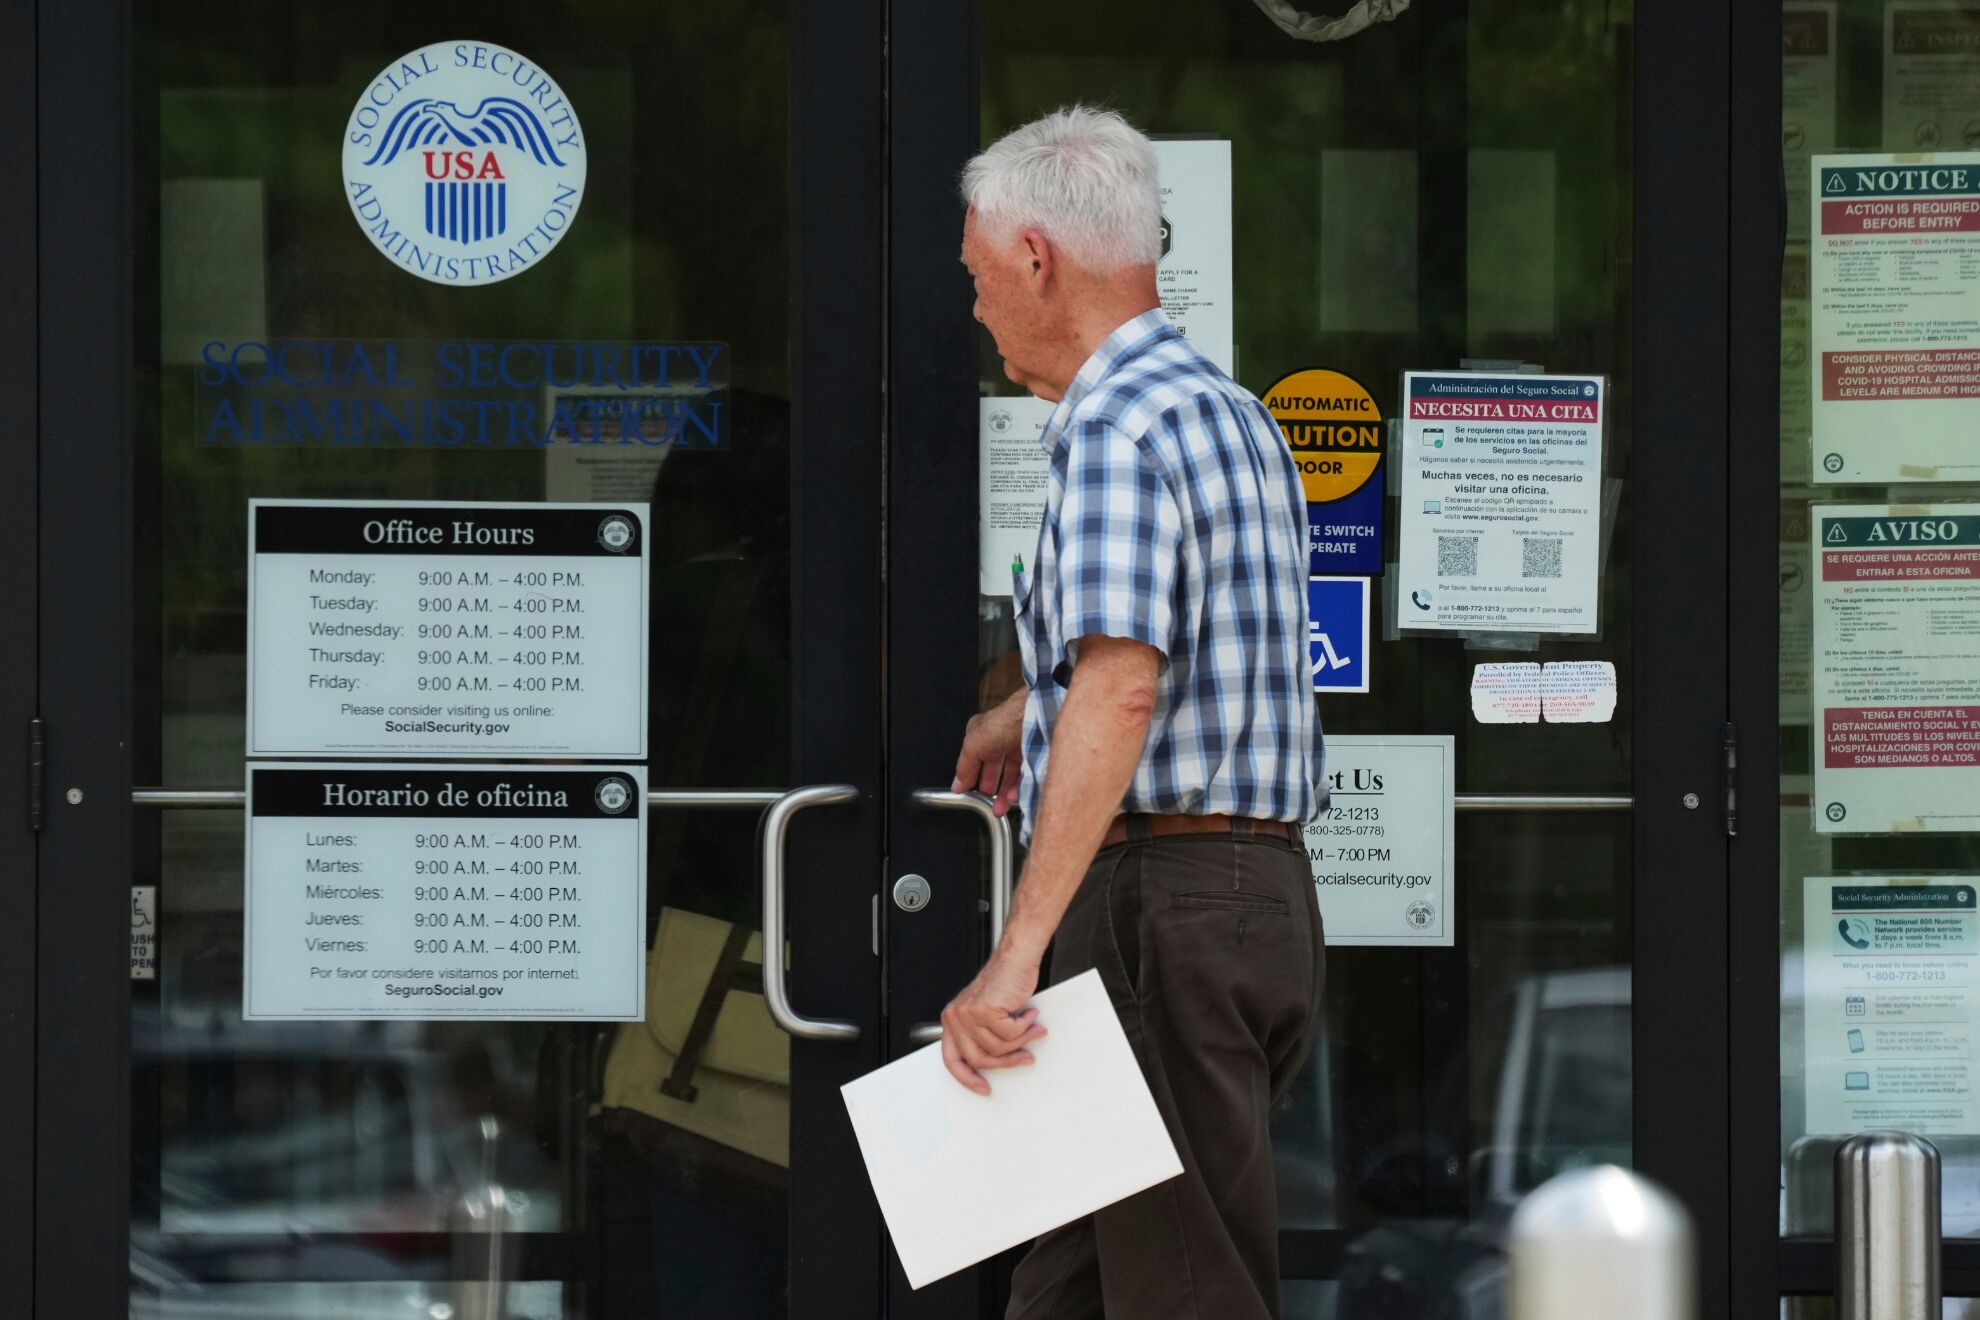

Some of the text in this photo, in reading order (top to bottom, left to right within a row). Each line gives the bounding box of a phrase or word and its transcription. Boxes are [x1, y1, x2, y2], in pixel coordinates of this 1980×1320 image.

[350, 44, 580, 150] SOCIAL SECURITY
[422, 152, 505, 180] USA
[1856, 170, 1968, 192] NOTICE
[1845, 202, 1979, 215] ACTION IS REQUIRED
[349, 179, 578, 280] ADMINISTRATION
[1863, 216, 1962, 229] BEFORE ENTRY
[203, 342, 721, 389] SOCIAL SECURITY
[1832, 355, 1882, 363] CONSIDER
[1885, 354, 1932, 363] PHYSICAL
[1844, 364, 1971, 374] AND AVOIDING CROWDING
[1838, 375, 1980, 385] COVID-19 HOSPITAL ADMISSIO
[1429, 383, 1579, 396] Administración del Seguro Social
[1840, 388, 1877, 397] LEVELS
[1880, 387, 1899, 396] ARE
[1903, 387, 1940, 395] MEDIUM
[1944, 386, 1958, 394] OR
[1268, 397, 1369, 411] AUTOMATIC
[1414, 402, 1594, 420] NECESITA UNA CITA
[205, 401, 722, 446] ADMINISTRATION
[1455, 426, 1465, 434] Se
[1468, 427, 1504, 436] requieren
[1527, 429, 1544, 437] para
[1546, 428, 1553, 436] la
[1280, 426, 1378, 447] AUTION
[1422, 471, 1583, 483] Muchas veces, no es necesario
[1454, 485, 1549, 495] visitar una oficina.
[363, 519, 535, 545] Office Hours
[1324, 525, 1375, 536] SWITCH
[1867, 521, 1959, 541] AVISO
[1309, 542, 1356, 553] PERATE
[1842, 554, 1890, 563] REQUIERE
[1892, 554, 1912, 562] UNA
[1915, 552, 1950, 561] ACCIÓN
[309, 568, 584, 587] Monday: 9:00 A.M. 4:00 P.M.
[1897, 568, 1904, 576] A
[1933, 567, 1971, 575] OFICINA
[309, 595, 585, 614] Tuesday: 9:00 A.M. 4:00 P.M.
[308, 621, 585, 641] Wednesday: 9:00 A.M. 4:00 P.M.
[308, 647, 584, 666] Thursday: 9:00 A.M. 4:00 P.M.
[309, 673, 584, 692] Friday: 9:00 A.M. 4:00 P.M.
[340, 703, 554, 720] Please consider visiting us online:
[385, 720, 510, 736] SocialSecurity.gov
[1354, 769, 1383, 790] Us
[323, 782, 430, 807] Horario
[437, 782, 469, 807] de
[476, 782, 569, 808] oficina
[1326, 808, 1379, 821] 72-1213
[306, 832, 582, 849] Lunes: 9:00 A.M. 4:00 P.M.
[1337, 848, 1390, 862] 7:00 PM
[306, 884, 582, 902] Miércoles: 9:00 A.M. 4:00 P.M.
[1861, 894, 1891, 902] Security
[1893, 893, 1949, 901] Administration
[305, 911, 581, 928] Jueves: 9:00 A.M. 4:00 P.M.
[304, 937, 581, 954] Viernes: 9:00 A.M. 4:00 P.M.
[131, 958, 153, 968] PEN
[310, 966, 579, 982] Por favor considere visitarnos por internet:
[1866, 971, 1945, 981] 1-800-772-1213
[385, 983, 504, 999] SeguroSocial.gov
